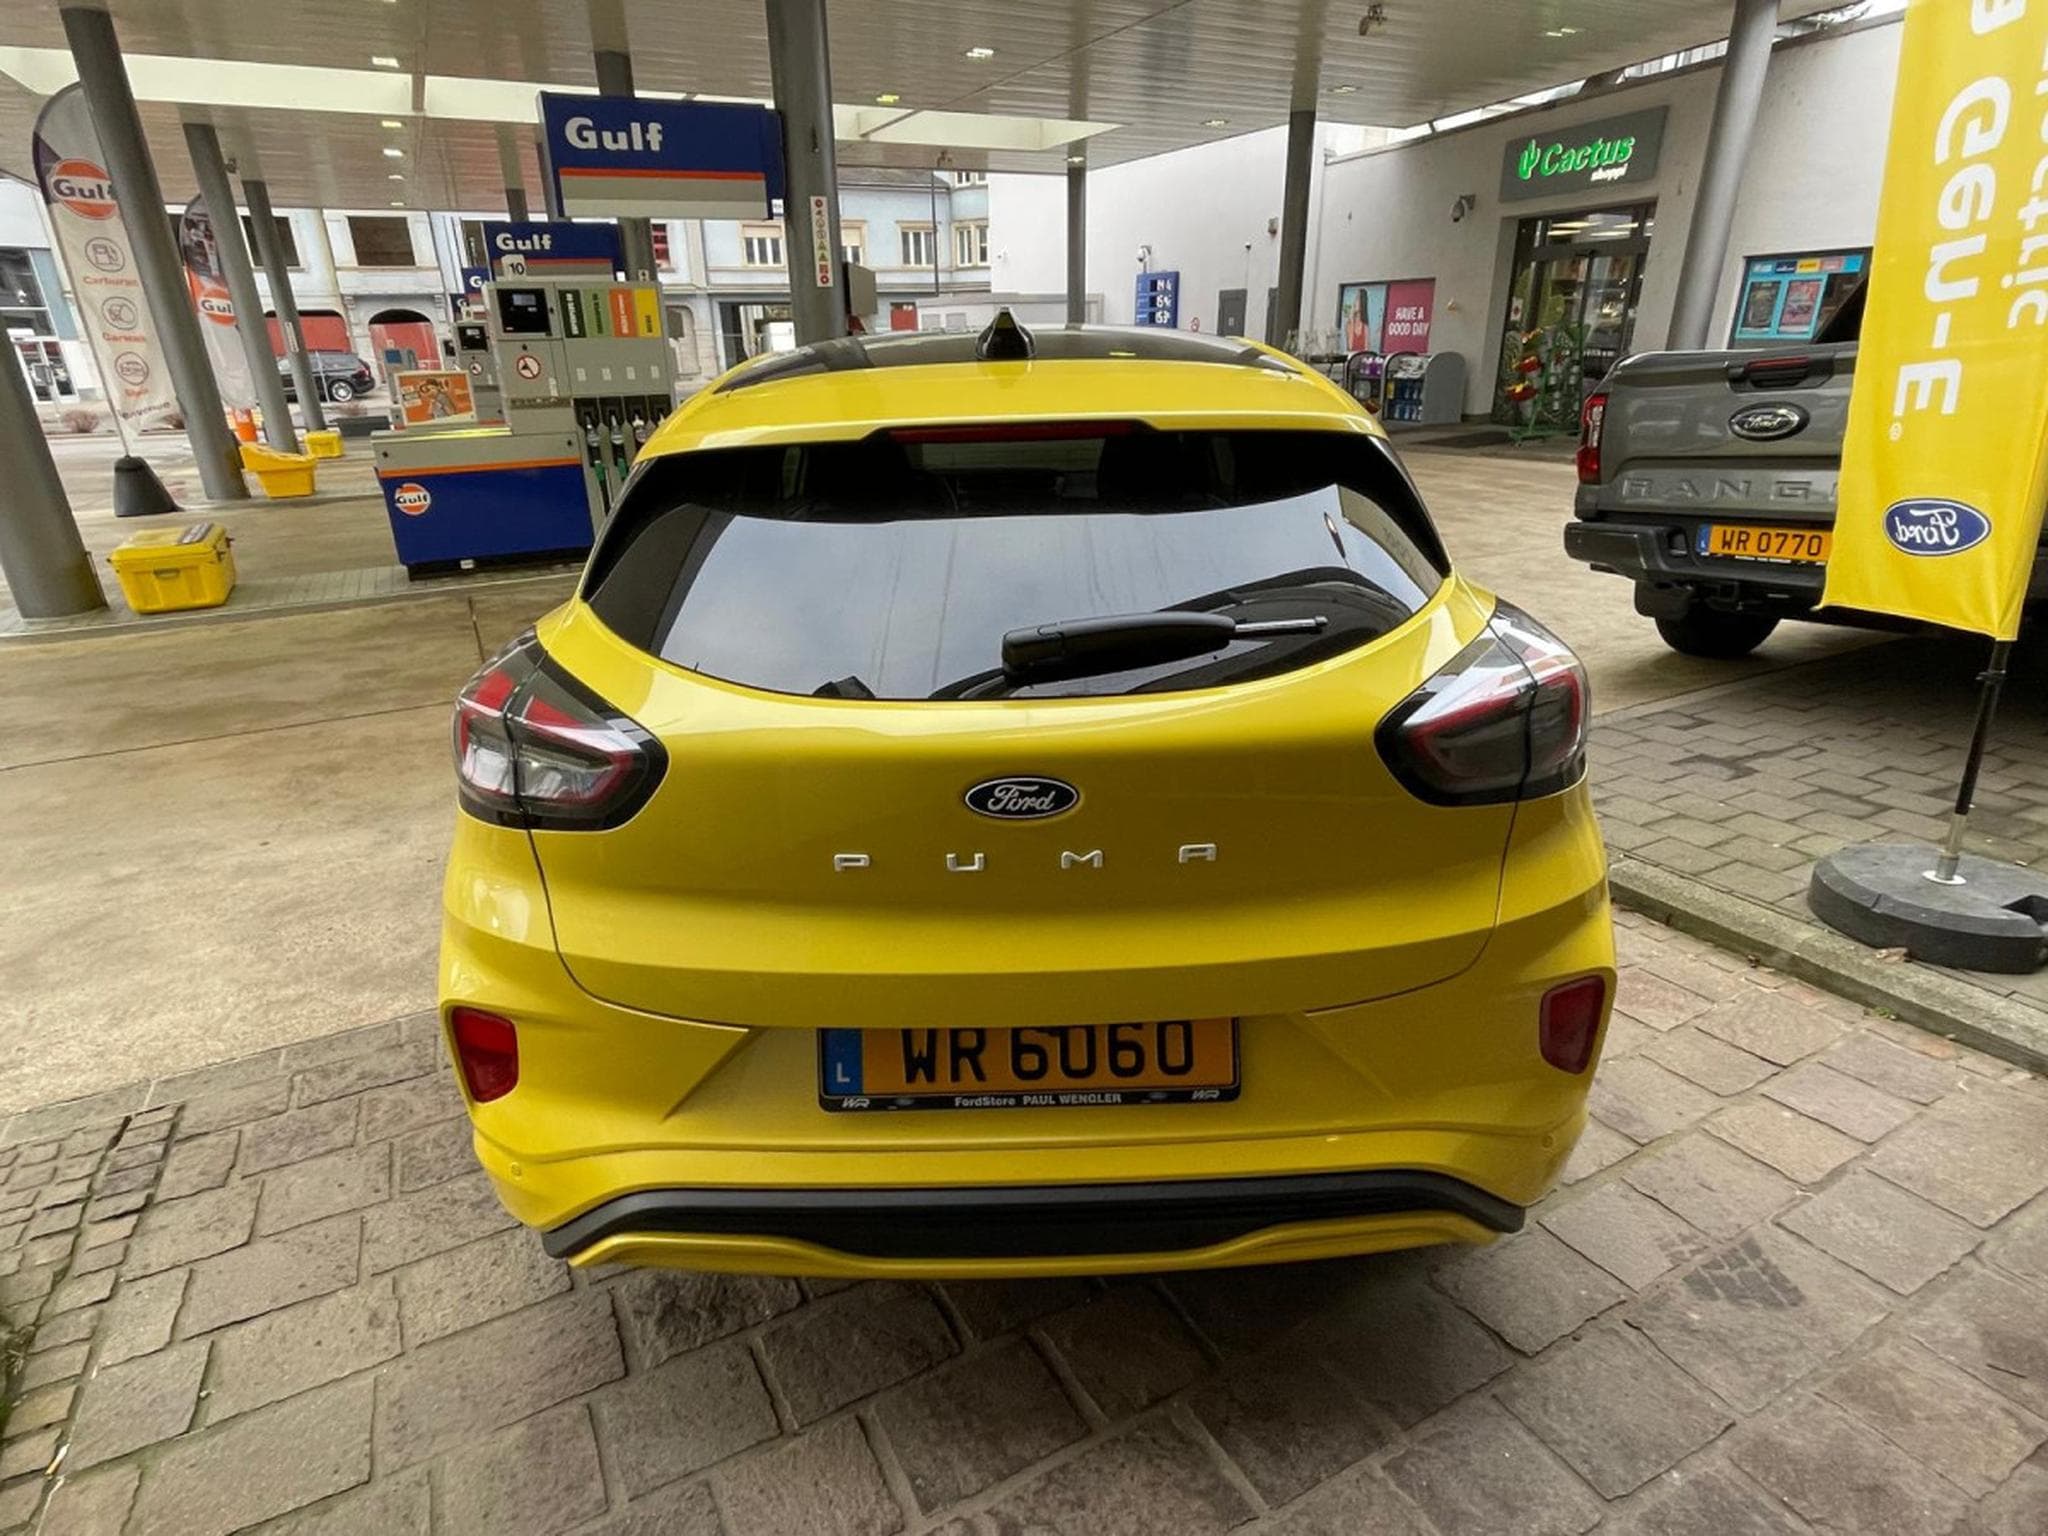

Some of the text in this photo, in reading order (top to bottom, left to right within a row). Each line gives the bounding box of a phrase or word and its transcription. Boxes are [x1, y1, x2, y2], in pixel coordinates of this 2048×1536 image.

[564, 116, 663, 152] Gulf
[1539, 136, 1636, 177] Cactus
[496, 233, 553, 251] Gulf
[509, 262, 525, 275] 10
[201, 299, 232, 314] Gul
[1395, 306, 1425, 320] HAVE A
[1388, 322, 1430, 336] GOOD DAY
[397, 493, 428, 505] Gulf
[1621, 478, 1839, 501] RANG
[1721, 529, 1823, 557] WR 0770
[987, 784, 1057, 811] Ford
[834, 843, 1217, 872] PUMA
[902, 1020, 1194, 1084] WR 6060
[836, 1063, 851, 1083] L
[954, 1093, 1123, 1107] FordStore PAUL WENGLER
